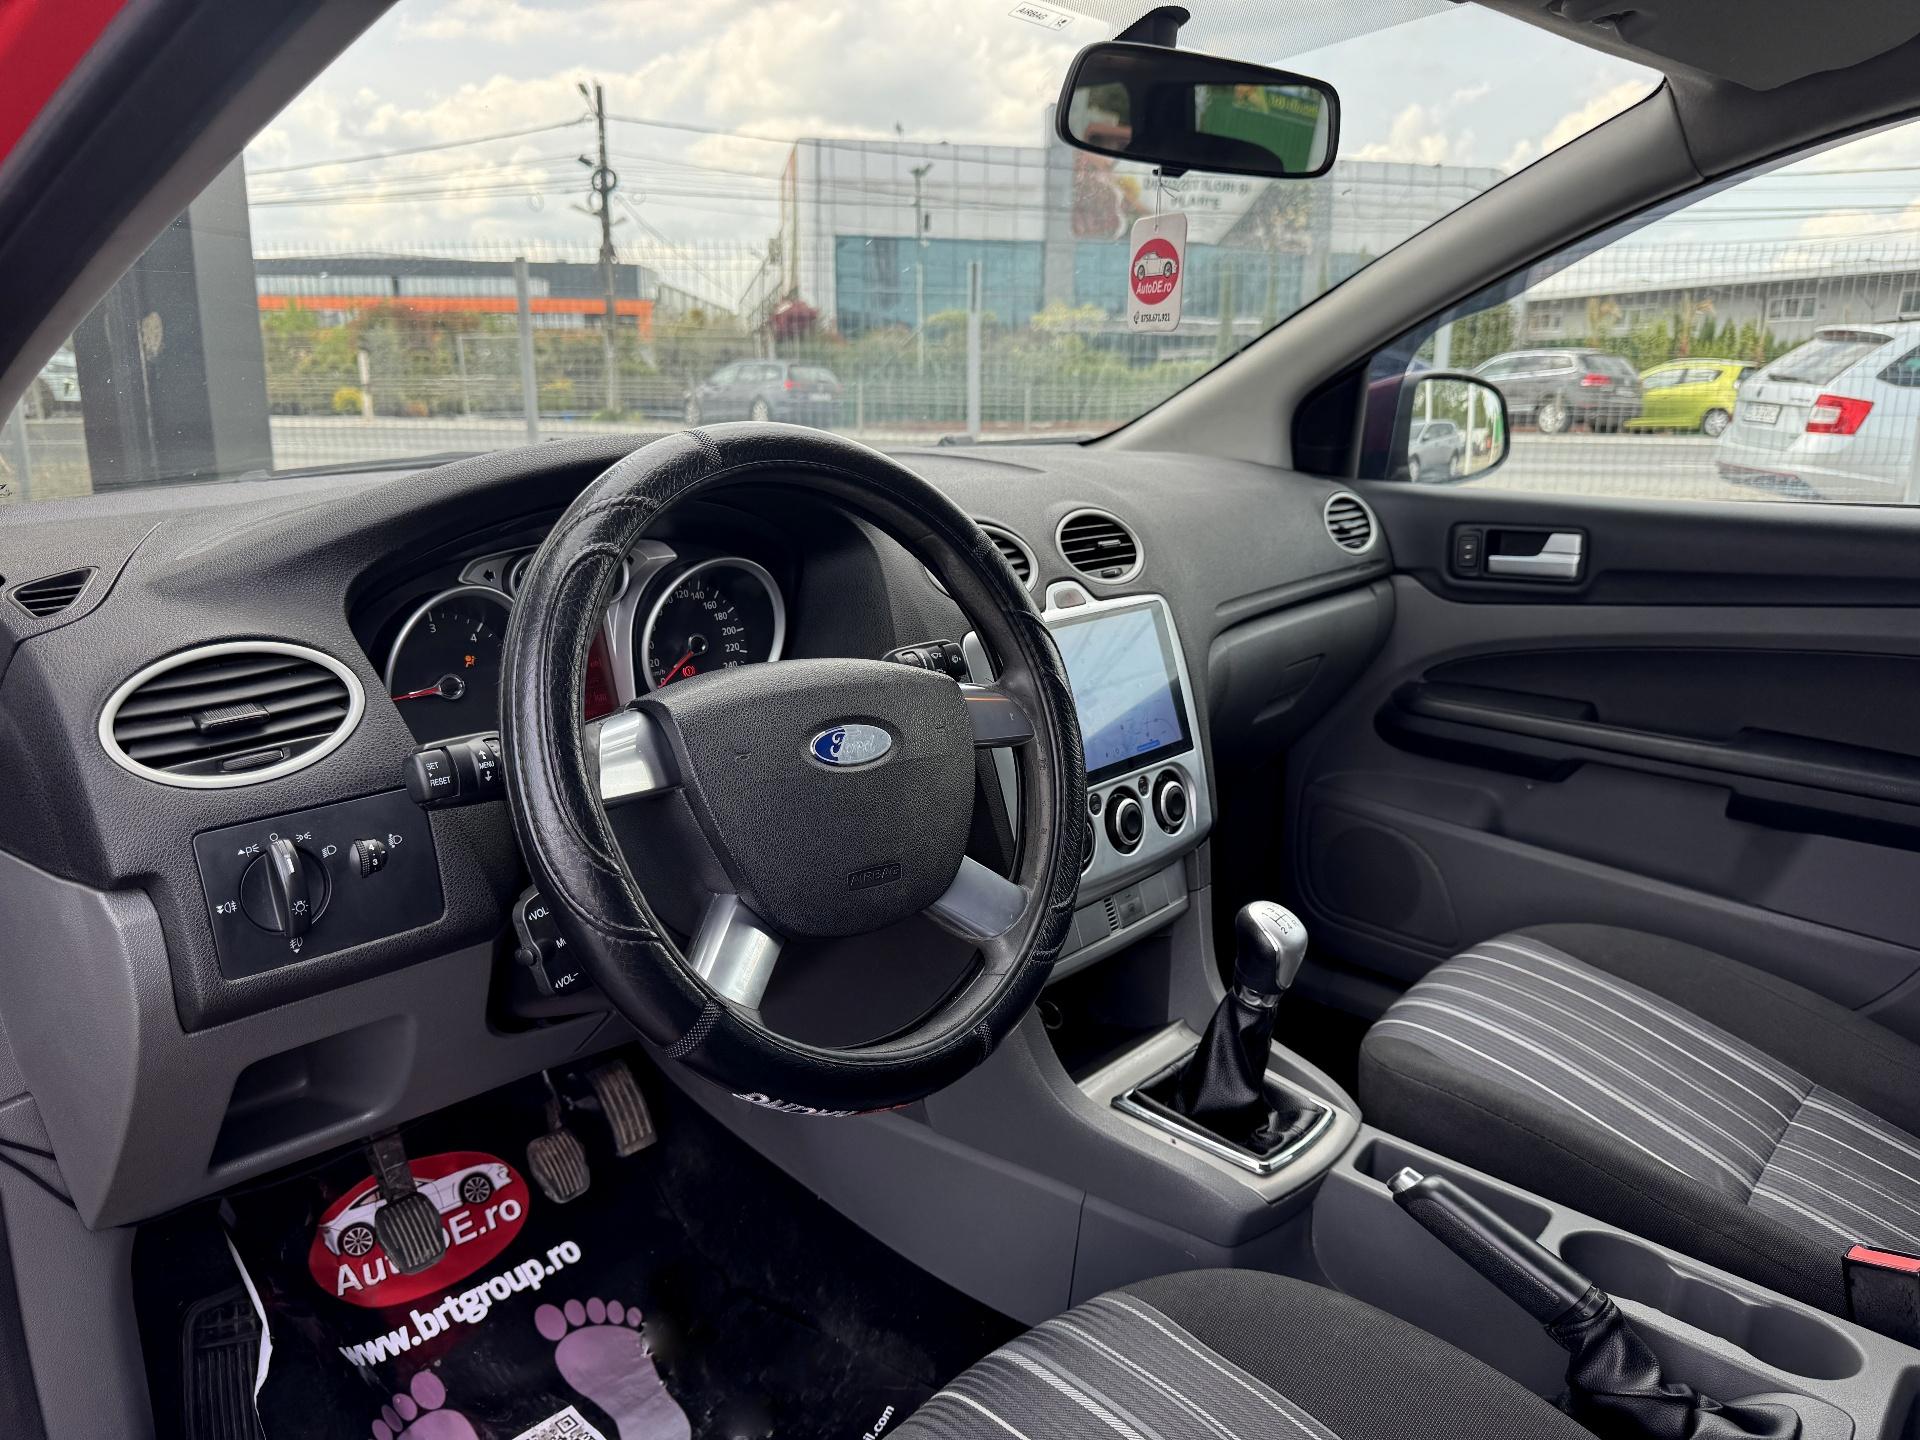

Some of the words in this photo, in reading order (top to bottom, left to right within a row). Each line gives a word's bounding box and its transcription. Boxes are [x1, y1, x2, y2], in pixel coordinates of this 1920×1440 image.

[1136, 280, 1172, 294] AutoDE.ro
[675, 590, 689, 599] 120
[691, 591, 705, 600] 140
[703, 600, 717, 610] 160
[714, 611, 728, 621] 180
[429, 623, 437, 633] 3
[721, 626, 737, 636] 200
[470, 633, 478, 643] 4
[724, 642, 740, 653] 220
[425, 761, 439, 770] SET
[478, 760, 495, 770] MENU
[430, 776, 450, 787] RESET
[338, 1240, 582, 1367] www.brtgroup.ro
